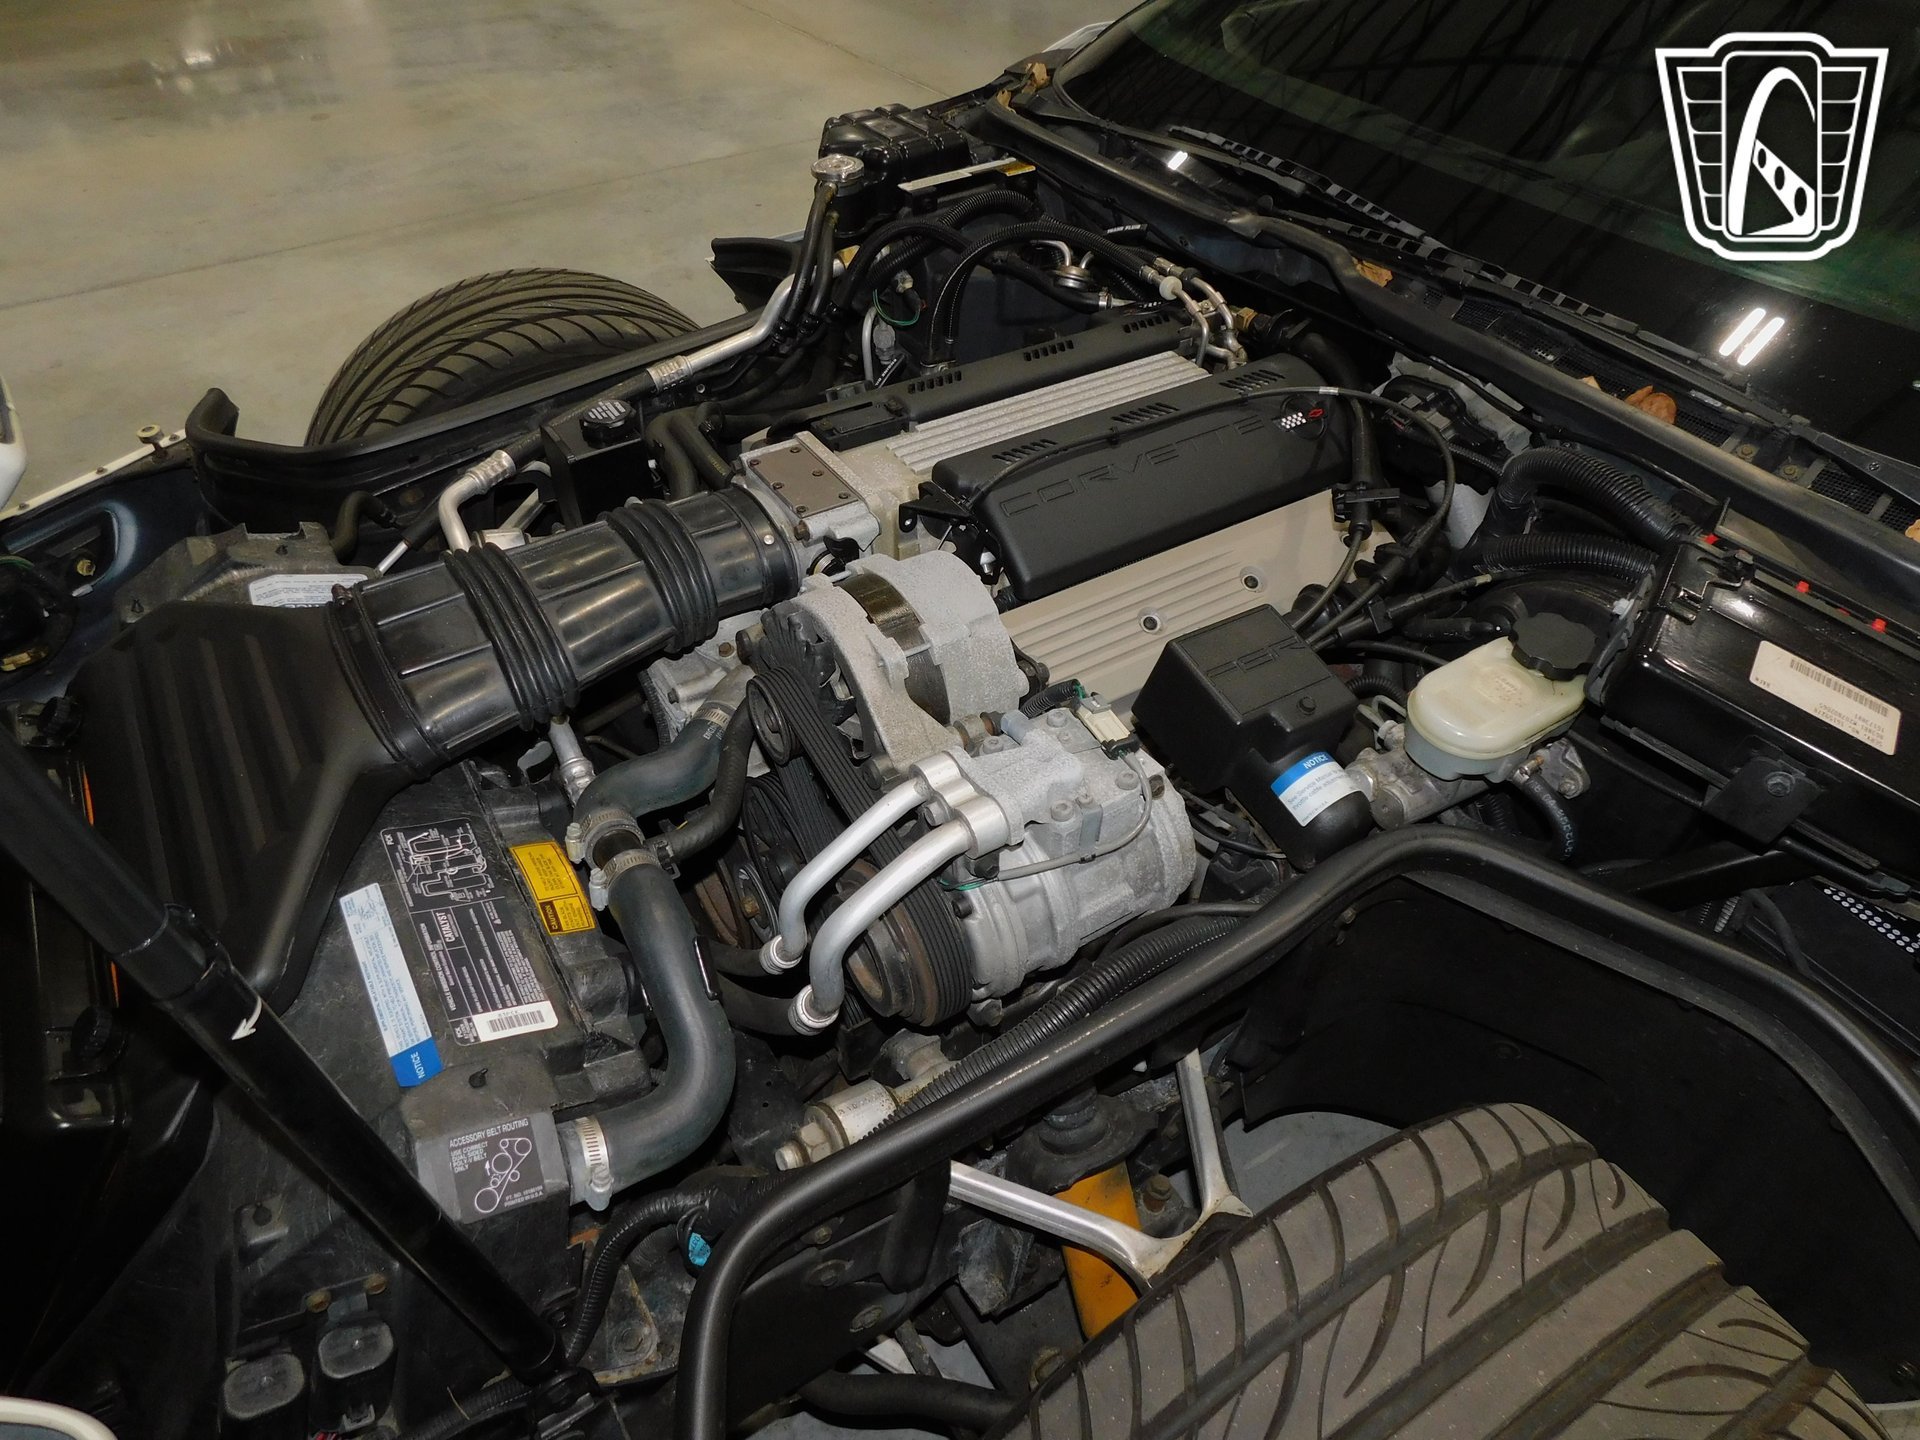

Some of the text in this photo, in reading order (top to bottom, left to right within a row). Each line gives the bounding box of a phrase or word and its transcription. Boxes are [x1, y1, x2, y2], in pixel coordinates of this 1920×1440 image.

[999, 415, 1265, 517] CORVETTE
[1303, 754, 1329, 769] NOTICE
[544, 904, 558, 929] CAUTION
[436, 912, 456, 942] CATALYST
[430, 950, 441, 971] CONTROL
[444, 991, 456, 1011] VEHICLE
[410, 1051, 425, 1078] NOTICE
[449, 1118, 529, 1148] ACCESSORY BELT ROUTING
[462, 1141, 488, 1154] CORRECT
[452, 1154, 466, 1163] DUAL
[473, 1153, 487, 1163] BELT
[454, 1165, 469, 1174] ONLY
